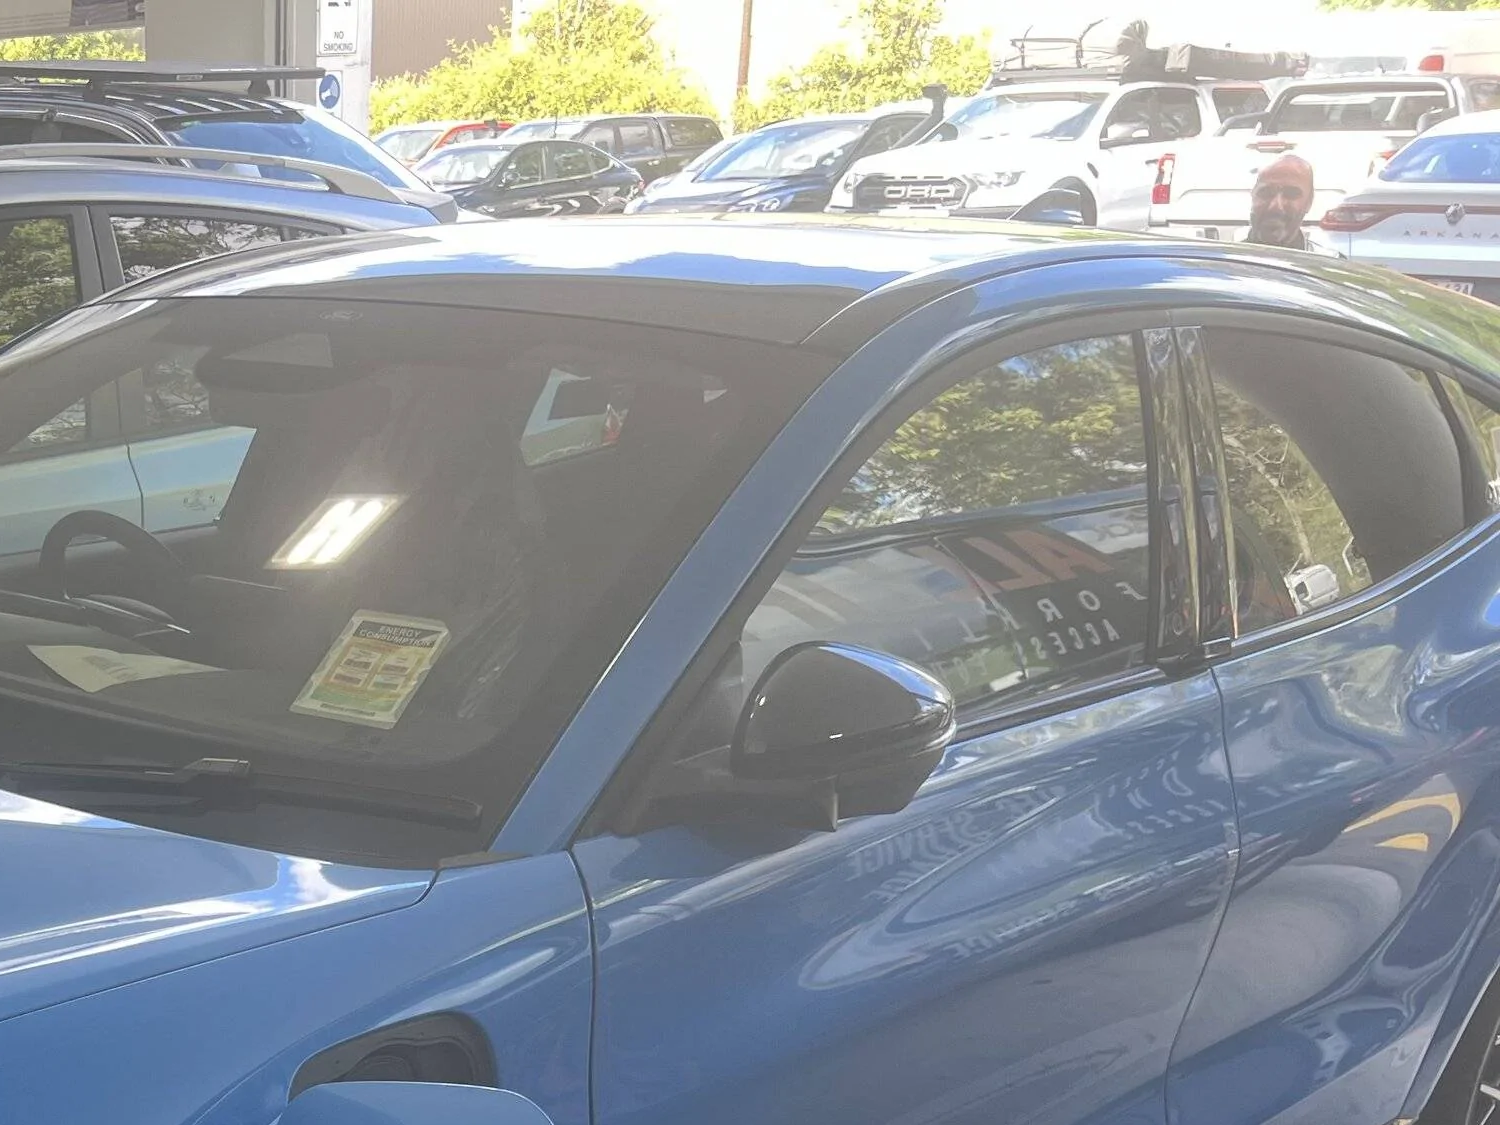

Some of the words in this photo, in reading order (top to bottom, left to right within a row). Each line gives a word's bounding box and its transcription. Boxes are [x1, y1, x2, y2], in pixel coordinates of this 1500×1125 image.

[333, 31, 344, 40] NO
[882, 185, 956, 199] ORD
[1403, 230, 1499, 239] ARKANA
[378, 625, 422, 638] ENERGY
[359, 629, 432, 648] CONSUMPTION
